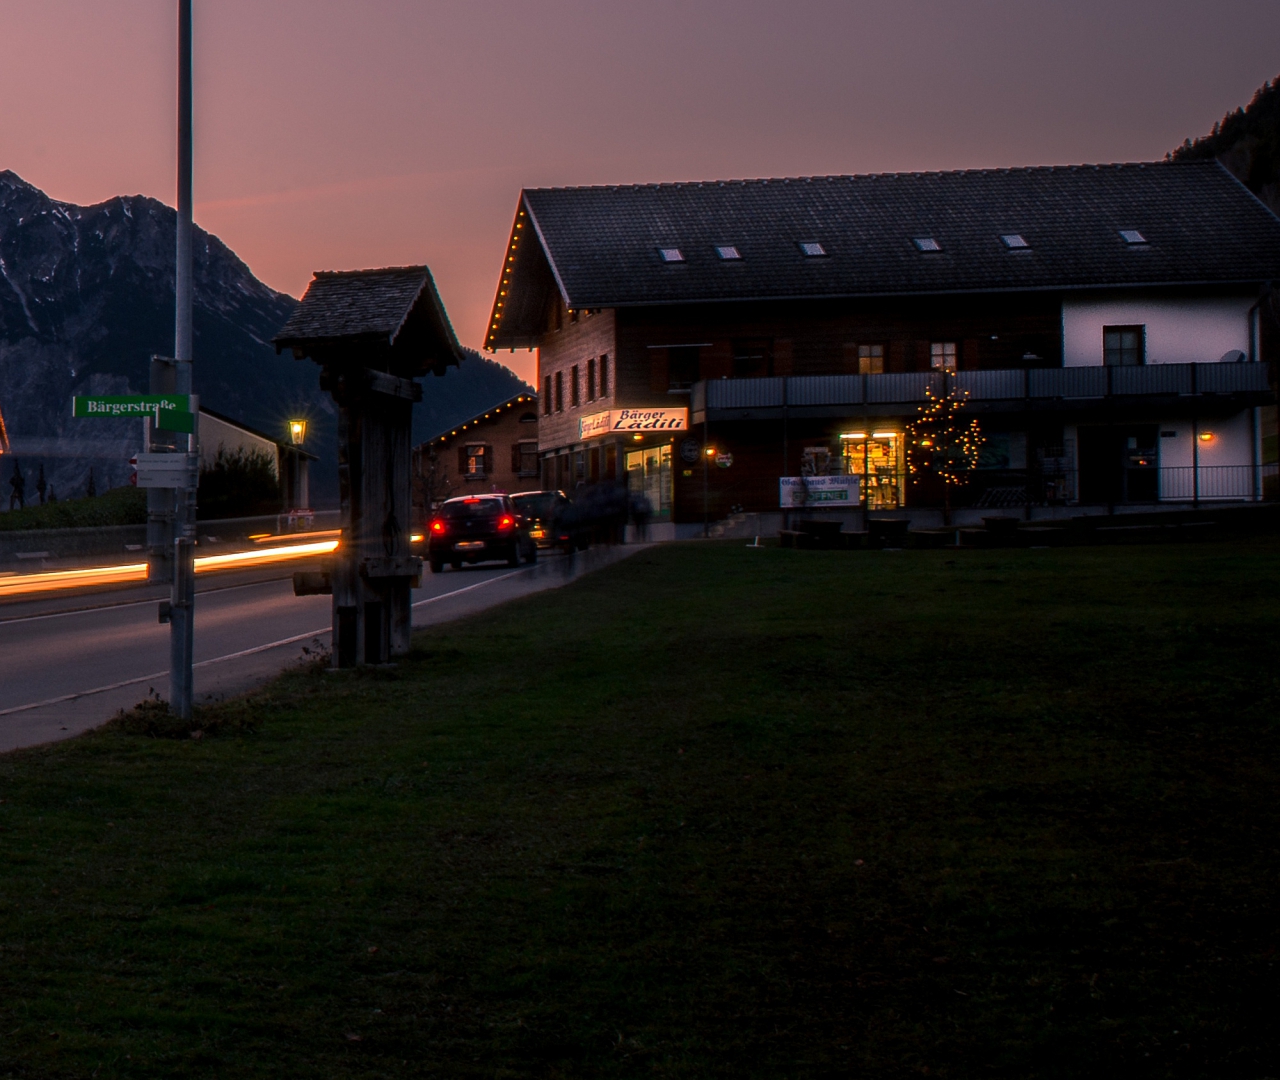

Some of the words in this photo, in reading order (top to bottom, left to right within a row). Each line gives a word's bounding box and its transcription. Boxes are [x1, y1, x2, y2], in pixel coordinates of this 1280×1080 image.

[87, 400, 176, 415] Bärgerstraße
[620, 410, 665, 422] Bärger
[781, 478, 826, 487] Gahaus
